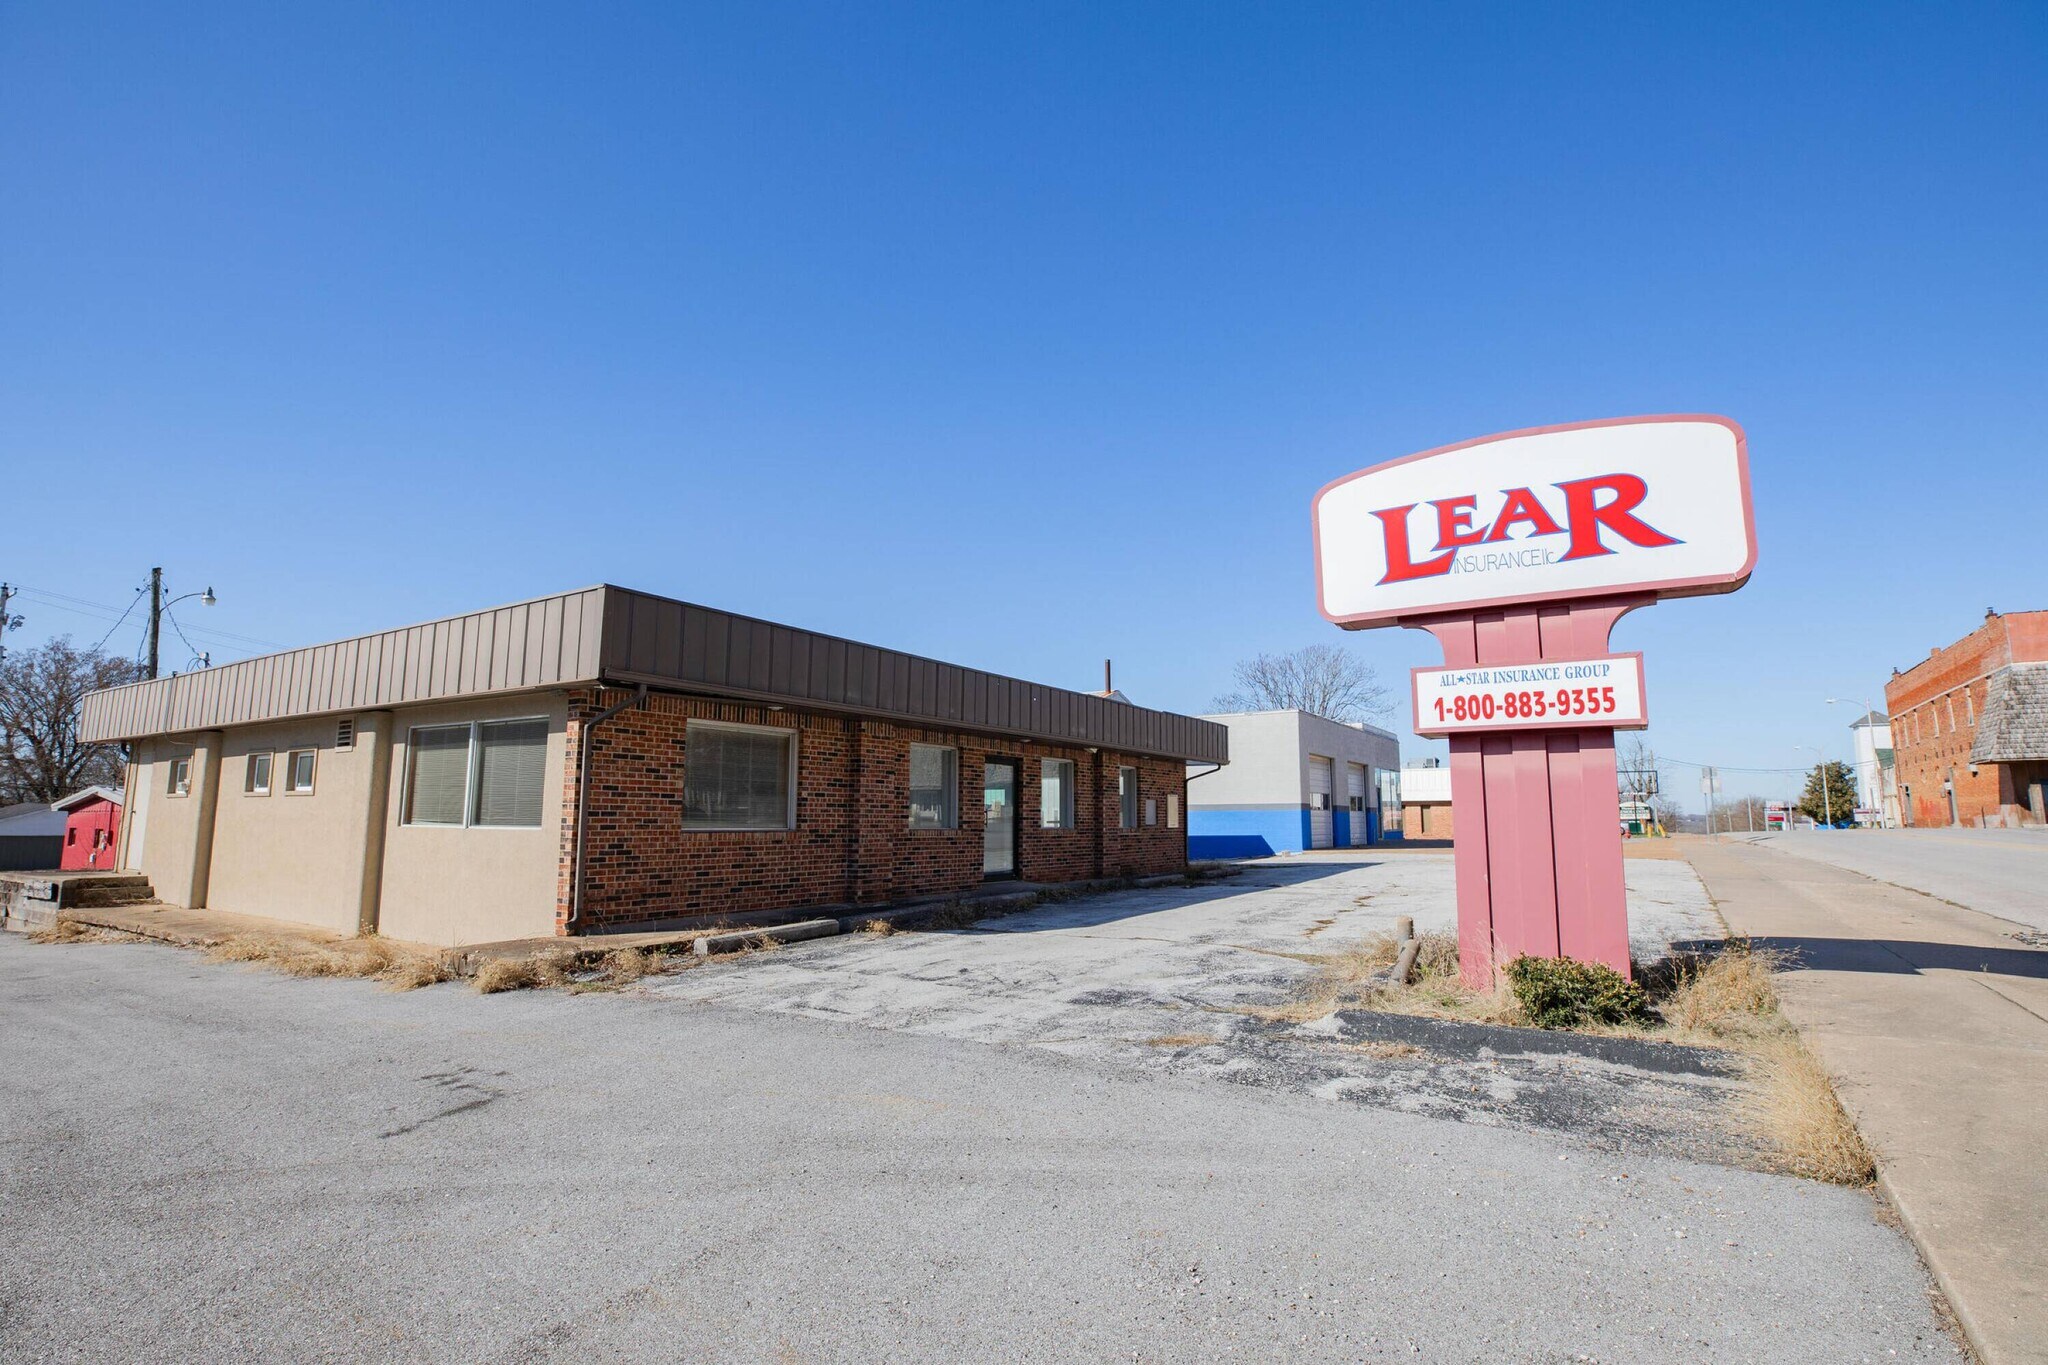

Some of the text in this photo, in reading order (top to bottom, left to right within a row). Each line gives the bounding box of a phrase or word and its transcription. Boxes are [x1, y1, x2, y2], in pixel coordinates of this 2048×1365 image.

[1368, 473, 1686, 586] LEAR
[1454, 549, 1540, 574] INSURANCE
[1494, 667, 1560, 684] INSURANCE
[1565, 663, 1610, 679] GROUP
[1434, 687, 1616, 722] 1-800-883-9355
